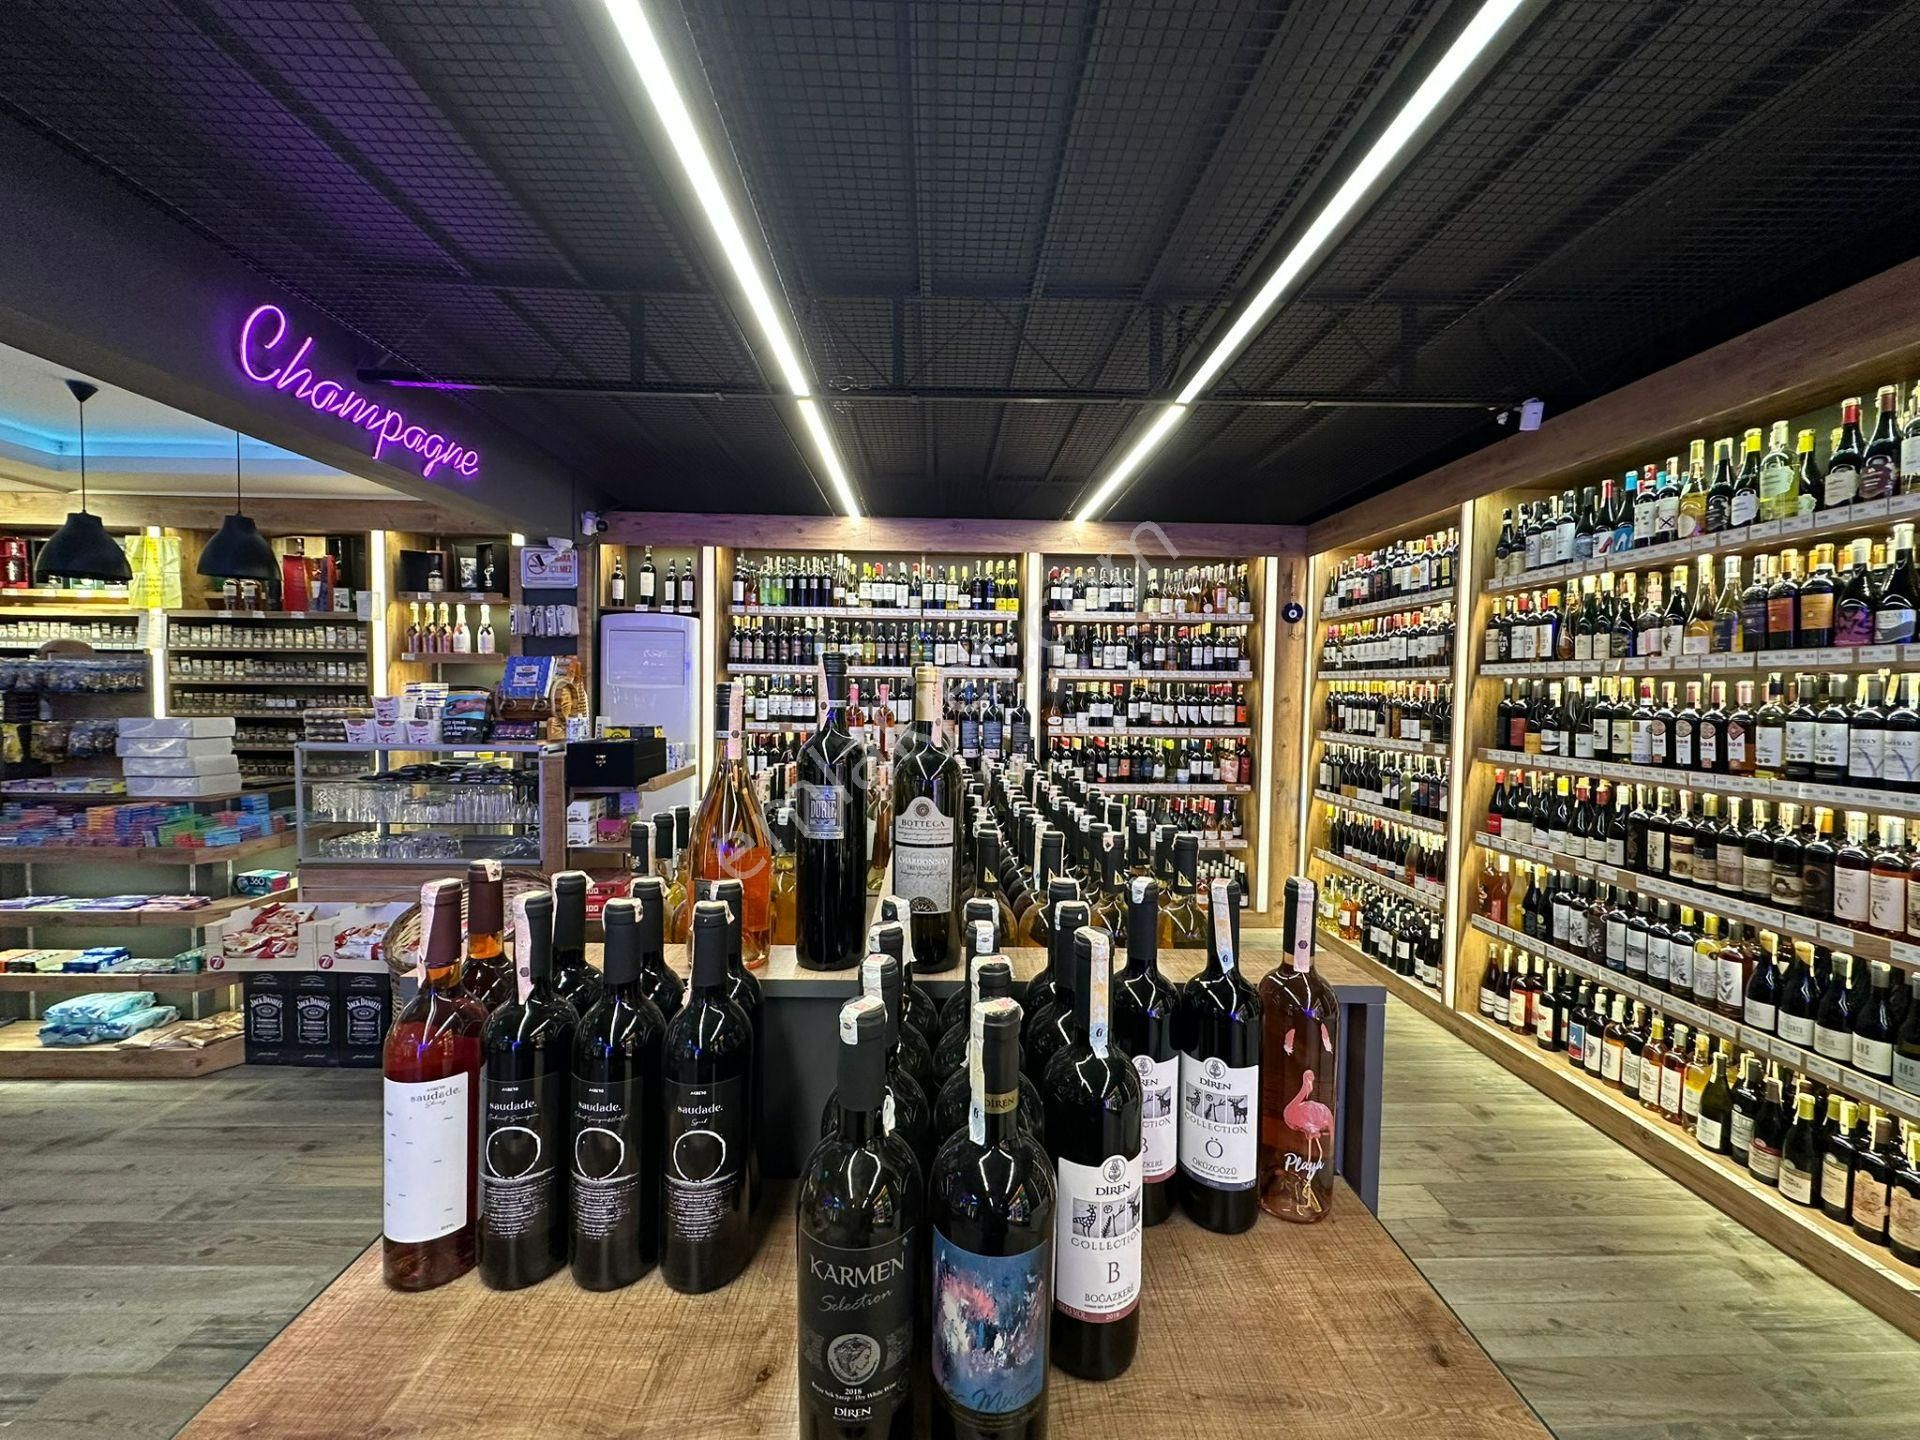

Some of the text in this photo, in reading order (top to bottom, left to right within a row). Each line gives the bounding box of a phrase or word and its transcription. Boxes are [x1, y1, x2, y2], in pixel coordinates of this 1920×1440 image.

[241, 304, 479, 477] Champagne
[901, 819, 945, 828] BOTTEGA
[249, 877, 265, 885] 360
[1140, 1078, 1158, 1087] REN
[1199, 1077, 1232, 1091] DİREN
[489, 1100, 538, 1111] saudade.
[677, 1103, 724, 1115] saudade.
[1184, 1111, 1249, 1134] COLLECTION
[1205, 1136, 1224, 1159] Ö
[1284, 1152, 1325, 1180] Playa
[1095, 1181, 1131, 1197] DİREN
[809, 1250, 905, 1288] KARMEN
[1107, 1261, 1121, 1285] B
[819, 1289, 893, 1312] Selection
[844, 1387, 863, 1396] 2018
[834, 1406, 872, 1419] DİREN
